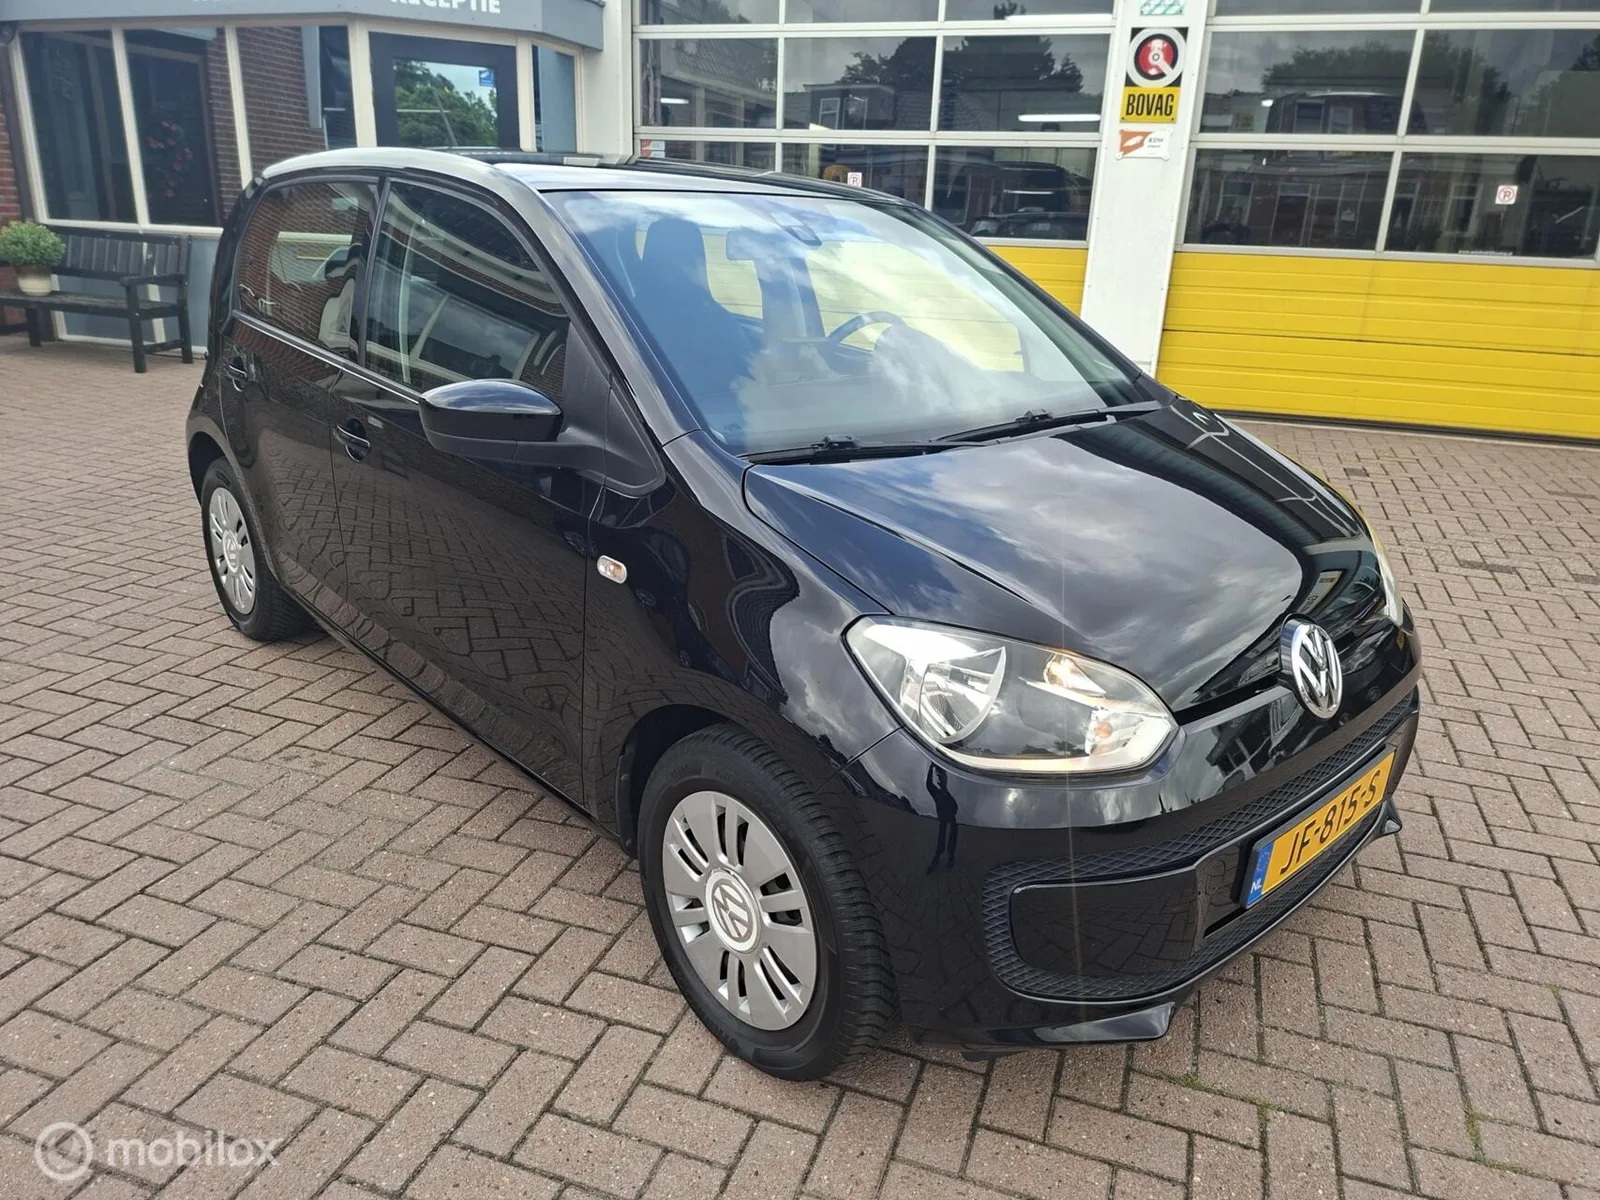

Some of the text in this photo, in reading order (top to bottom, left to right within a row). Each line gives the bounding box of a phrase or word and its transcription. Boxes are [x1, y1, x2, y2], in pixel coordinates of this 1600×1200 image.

[390, 0, 501, 14] PTIE
[1126, 93, 1174, 116] BOVAG
[1280, 769, 1381, 875] JF-815-S
[1250, 878, 1262, 893] NL
